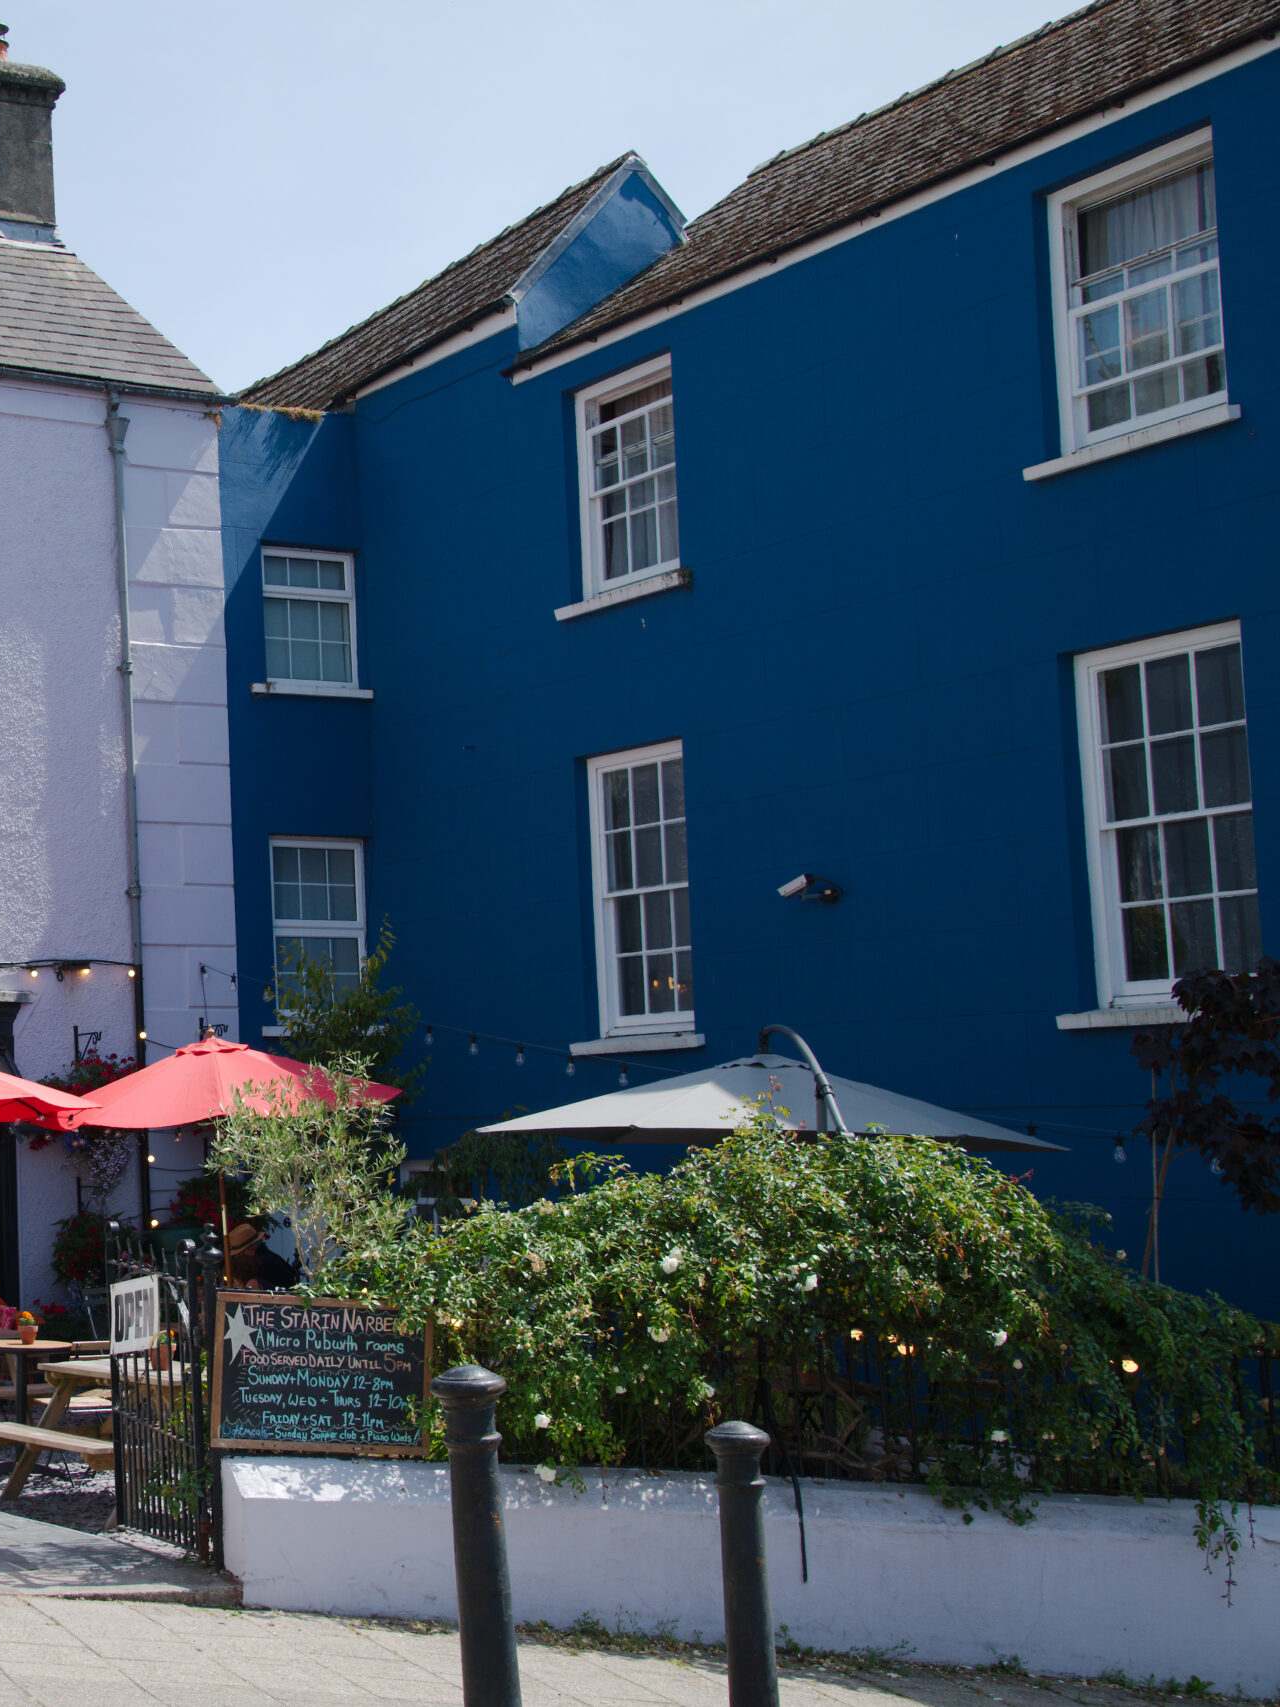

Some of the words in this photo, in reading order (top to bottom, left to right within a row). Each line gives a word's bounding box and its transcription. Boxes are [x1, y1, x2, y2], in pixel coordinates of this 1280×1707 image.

[283, 1217, 291, 1228] 6
[115, 1287, 154, 1343] OPEN
[244, 1305, 275, 1327] THE
[281, 1306, 321, 1330] STAR
[322, 1314, 339, 1330] IN
[306, 1329, 331, 1350] Pub
[366, 1341, 405, 1354] rooms
[242, 1350, 270, 1365] FOOD
[270, 1353, 308, 1367] SERVED
[308, 1354, 345, 1368] DAILY
[348, 1355, 382, 1369] UNTIL
[384, 1353, 411, 1373] 5PM
[288, 1393, 317, 1407] WED
[329, 1390, 361, 1408] THURS
[368, 1393, 408, 1410] 12-10P
[262, 1410, 300, 1425] FRIDAY
